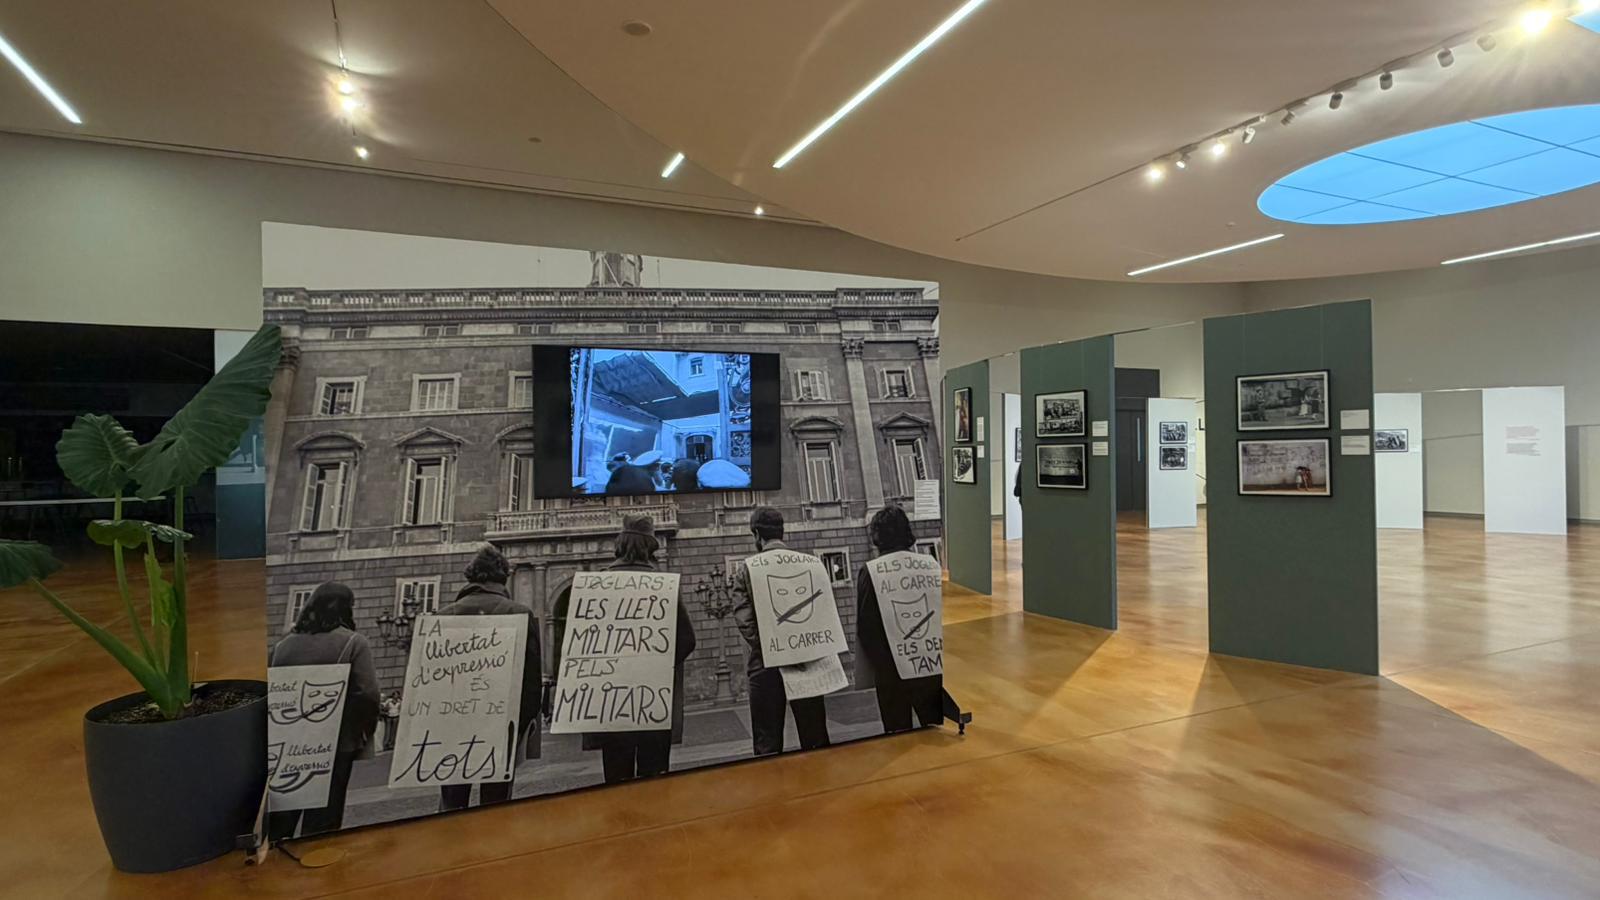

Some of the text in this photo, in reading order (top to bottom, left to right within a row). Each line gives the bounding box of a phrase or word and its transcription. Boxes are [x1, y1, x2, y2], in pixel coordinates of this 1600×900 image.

[876, 559, 902, 574] ELS
[880, 579, 898, 594] AL
[574, 595, 670, 621] LES LLEIS
[418, 618, 442, 637] LA
[425, 627, 502, 661] llibertat
[566, 623, 670, 656] MILITARS
[769, 629, 835, 652] AL CARRER
[896, 641, 918, 657] ELS
[408, 699, 505, 717] UN DRET DE
[554, 681, 672, 725] MILITARS
